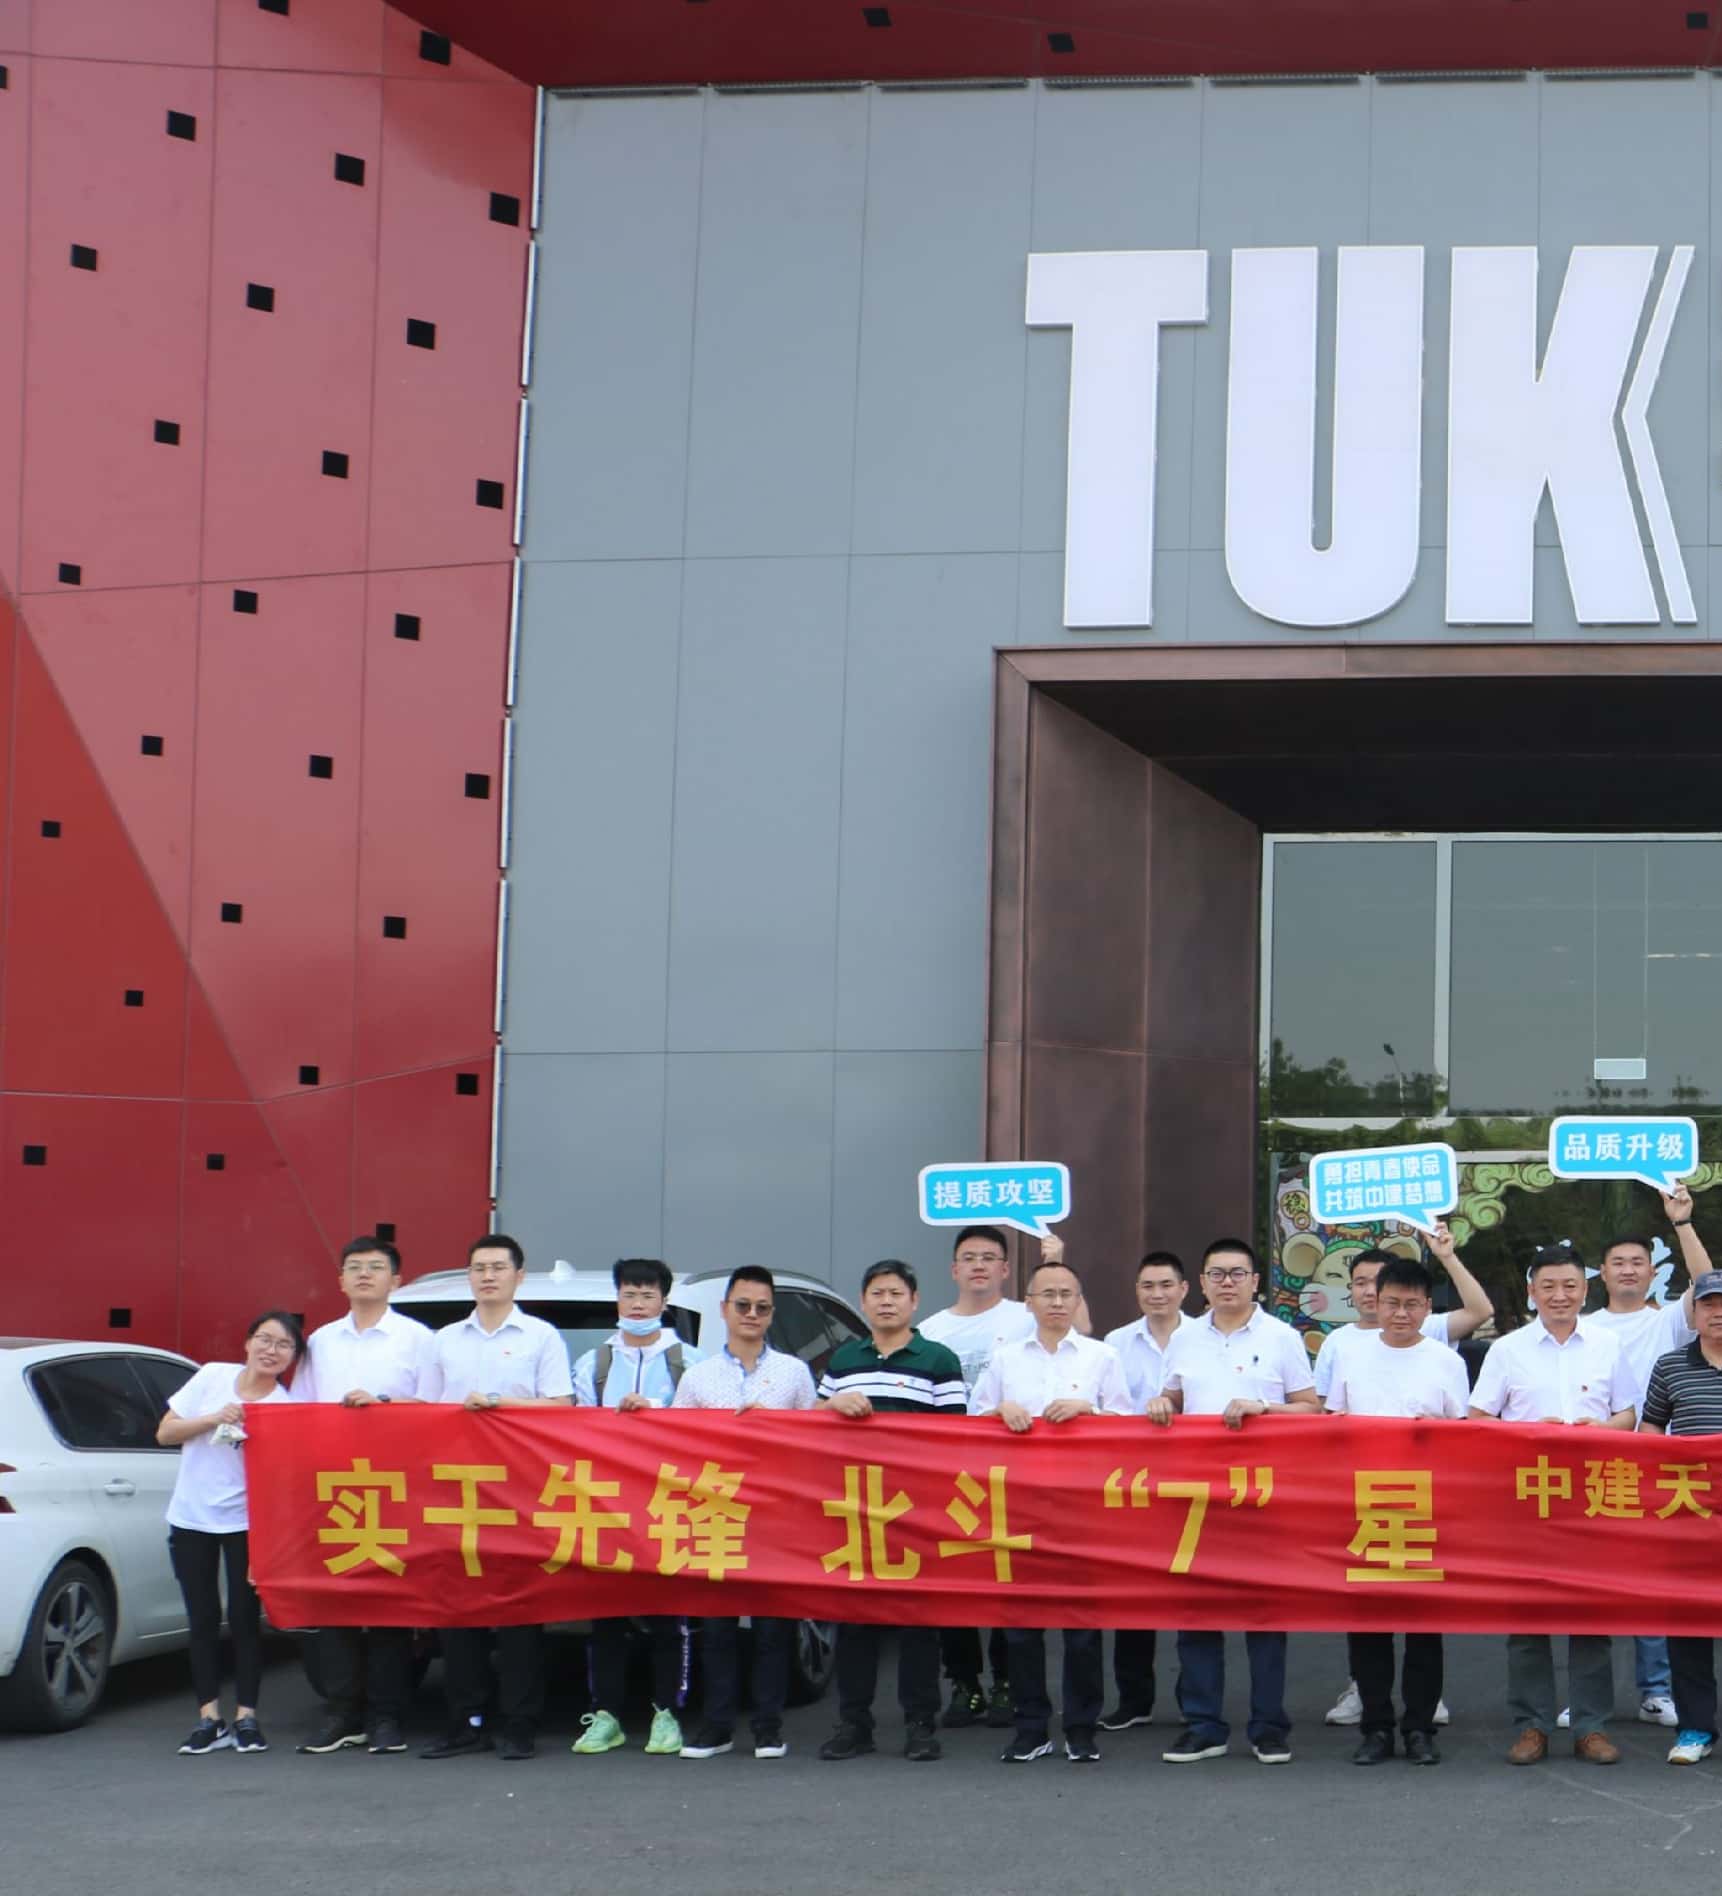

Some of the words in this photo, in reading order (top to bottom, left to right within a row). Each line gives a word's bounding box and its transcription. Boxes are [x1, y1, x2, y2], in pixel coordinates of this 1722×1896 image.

[1026, 245, 1697, 628] TUK
[1563, 1132, 1685, 1161] 品质升级
[933, 1175, 1055, 1211] 提质攻坚
[317, 1459, 751, 1582] 实干先锋
